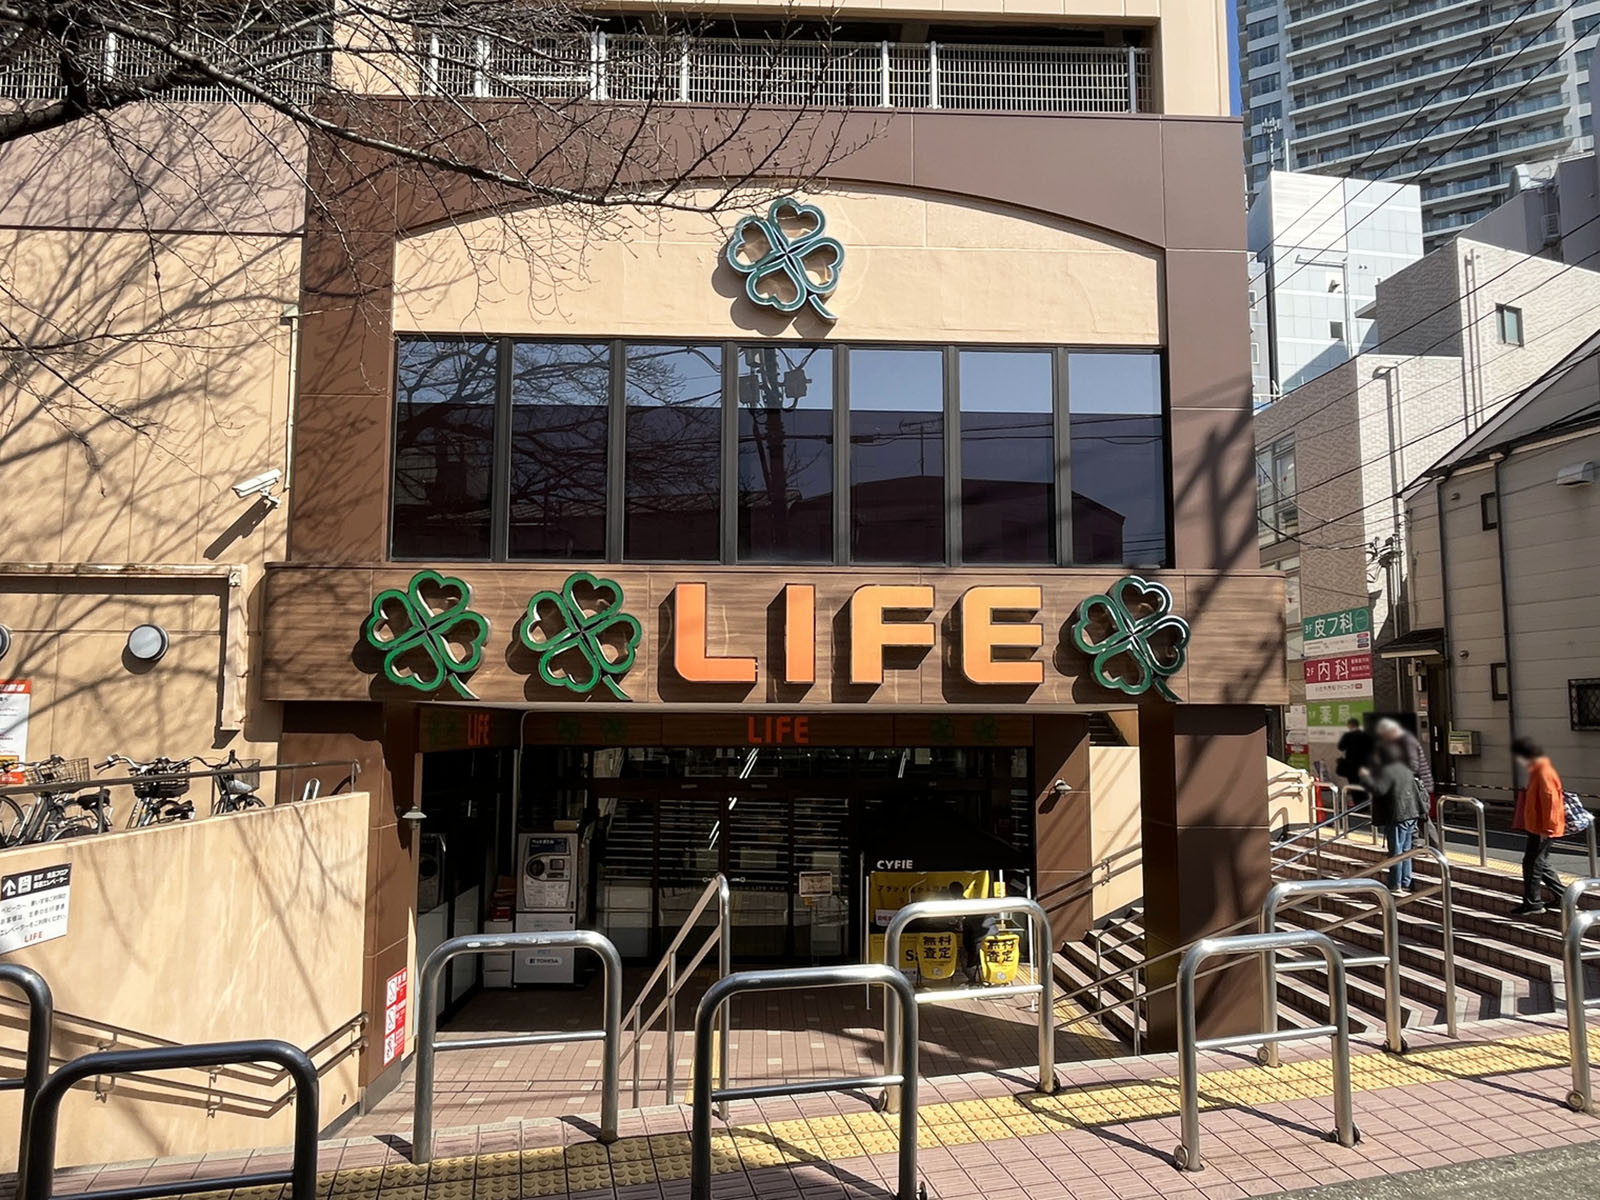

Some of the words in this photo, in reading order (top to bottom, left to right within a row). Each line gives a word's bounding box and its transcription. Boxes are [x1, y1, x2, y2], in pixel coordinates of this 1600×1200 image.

[674, 581, 1045, 685] LIFE
[1314, 611, 1353, 637] 皮フ科
[1306, 667, 1315, 677] 2F
[1317, 658, 1349, 681] 内科
[747, 715, 810, 745] LIFE
[24, 930, 43, 943] LIFE
[923, 934, 952, 946] 無料
[923, 946, 952, 960] 査定
